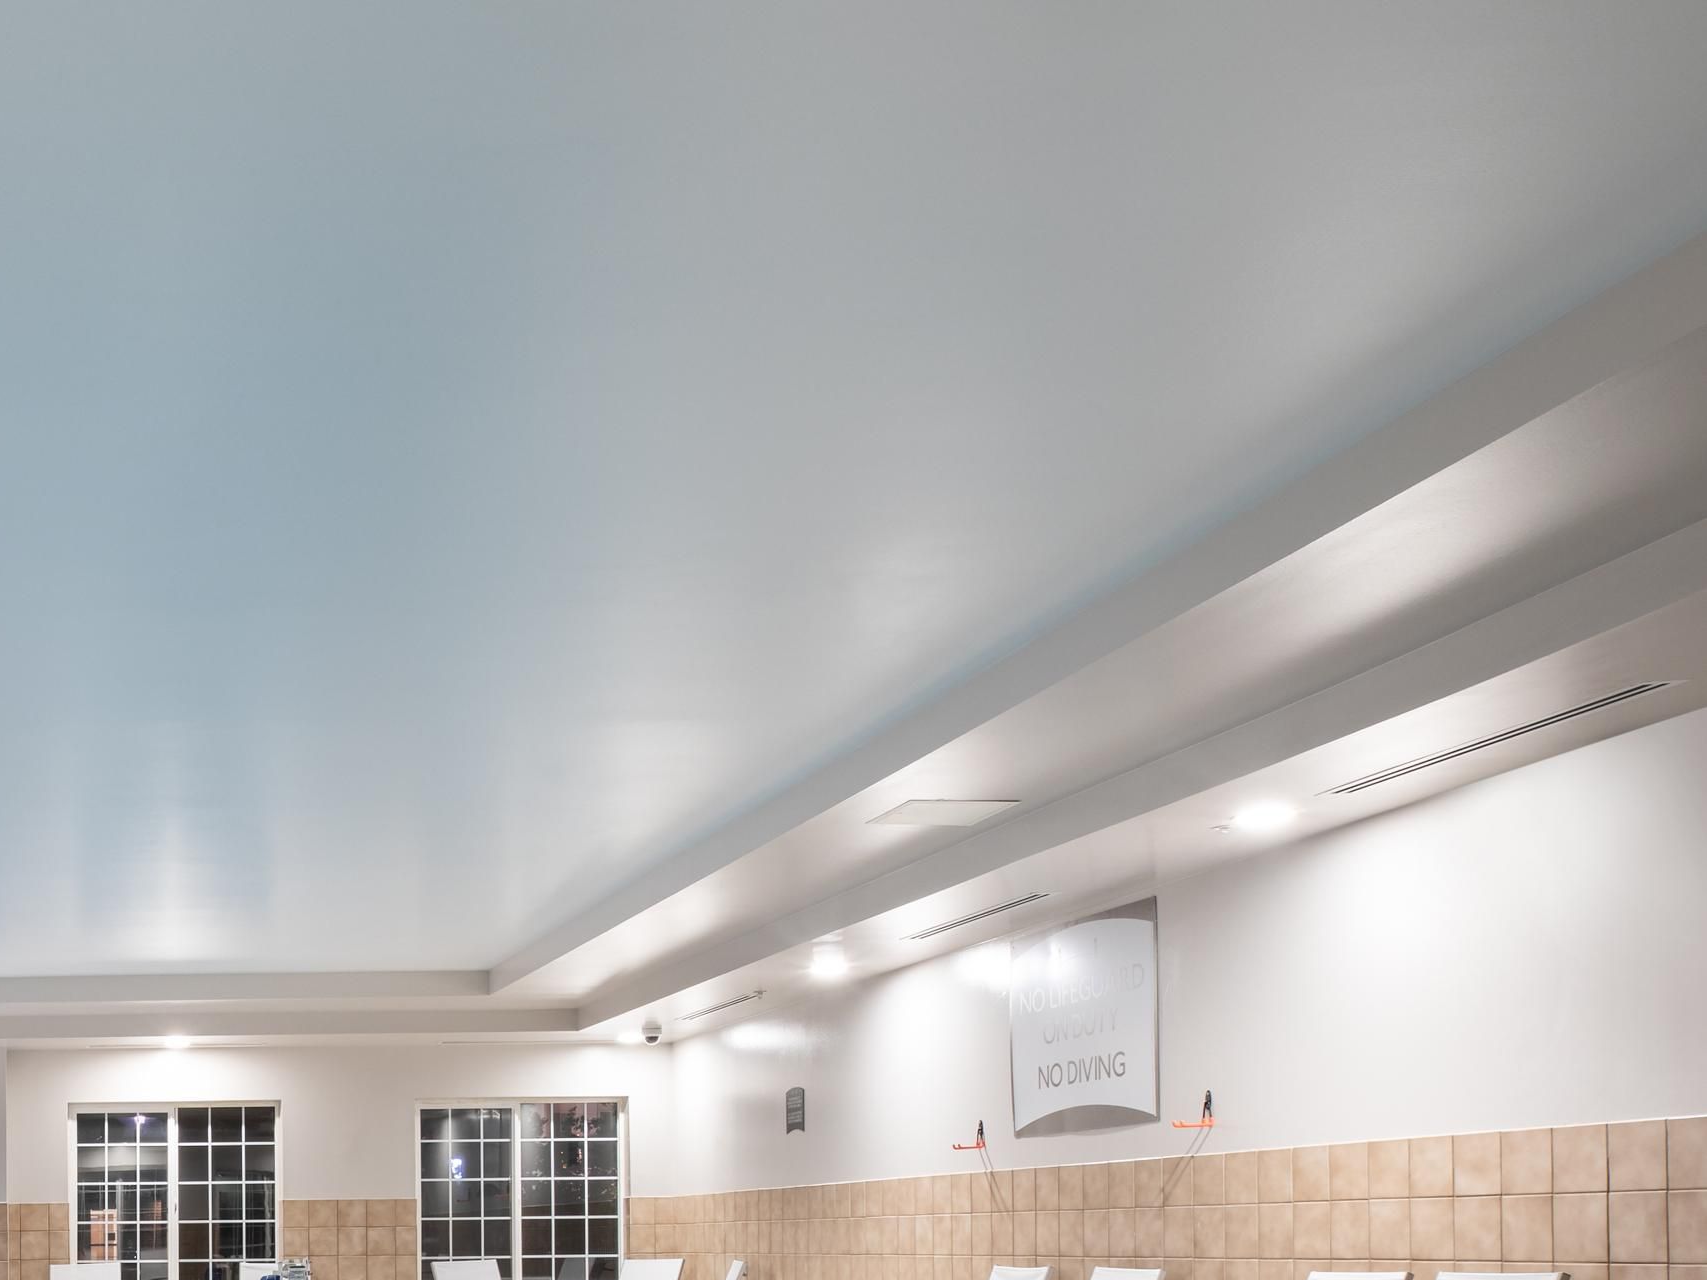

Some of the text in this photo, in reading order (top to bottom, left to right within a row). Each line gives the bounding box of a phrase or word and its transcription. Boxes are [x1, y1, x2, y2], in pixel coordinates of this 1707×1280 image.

[1019, 987, 1045, 1014] NO
[1038, 1051, 1126, 1089] NO DIVING
